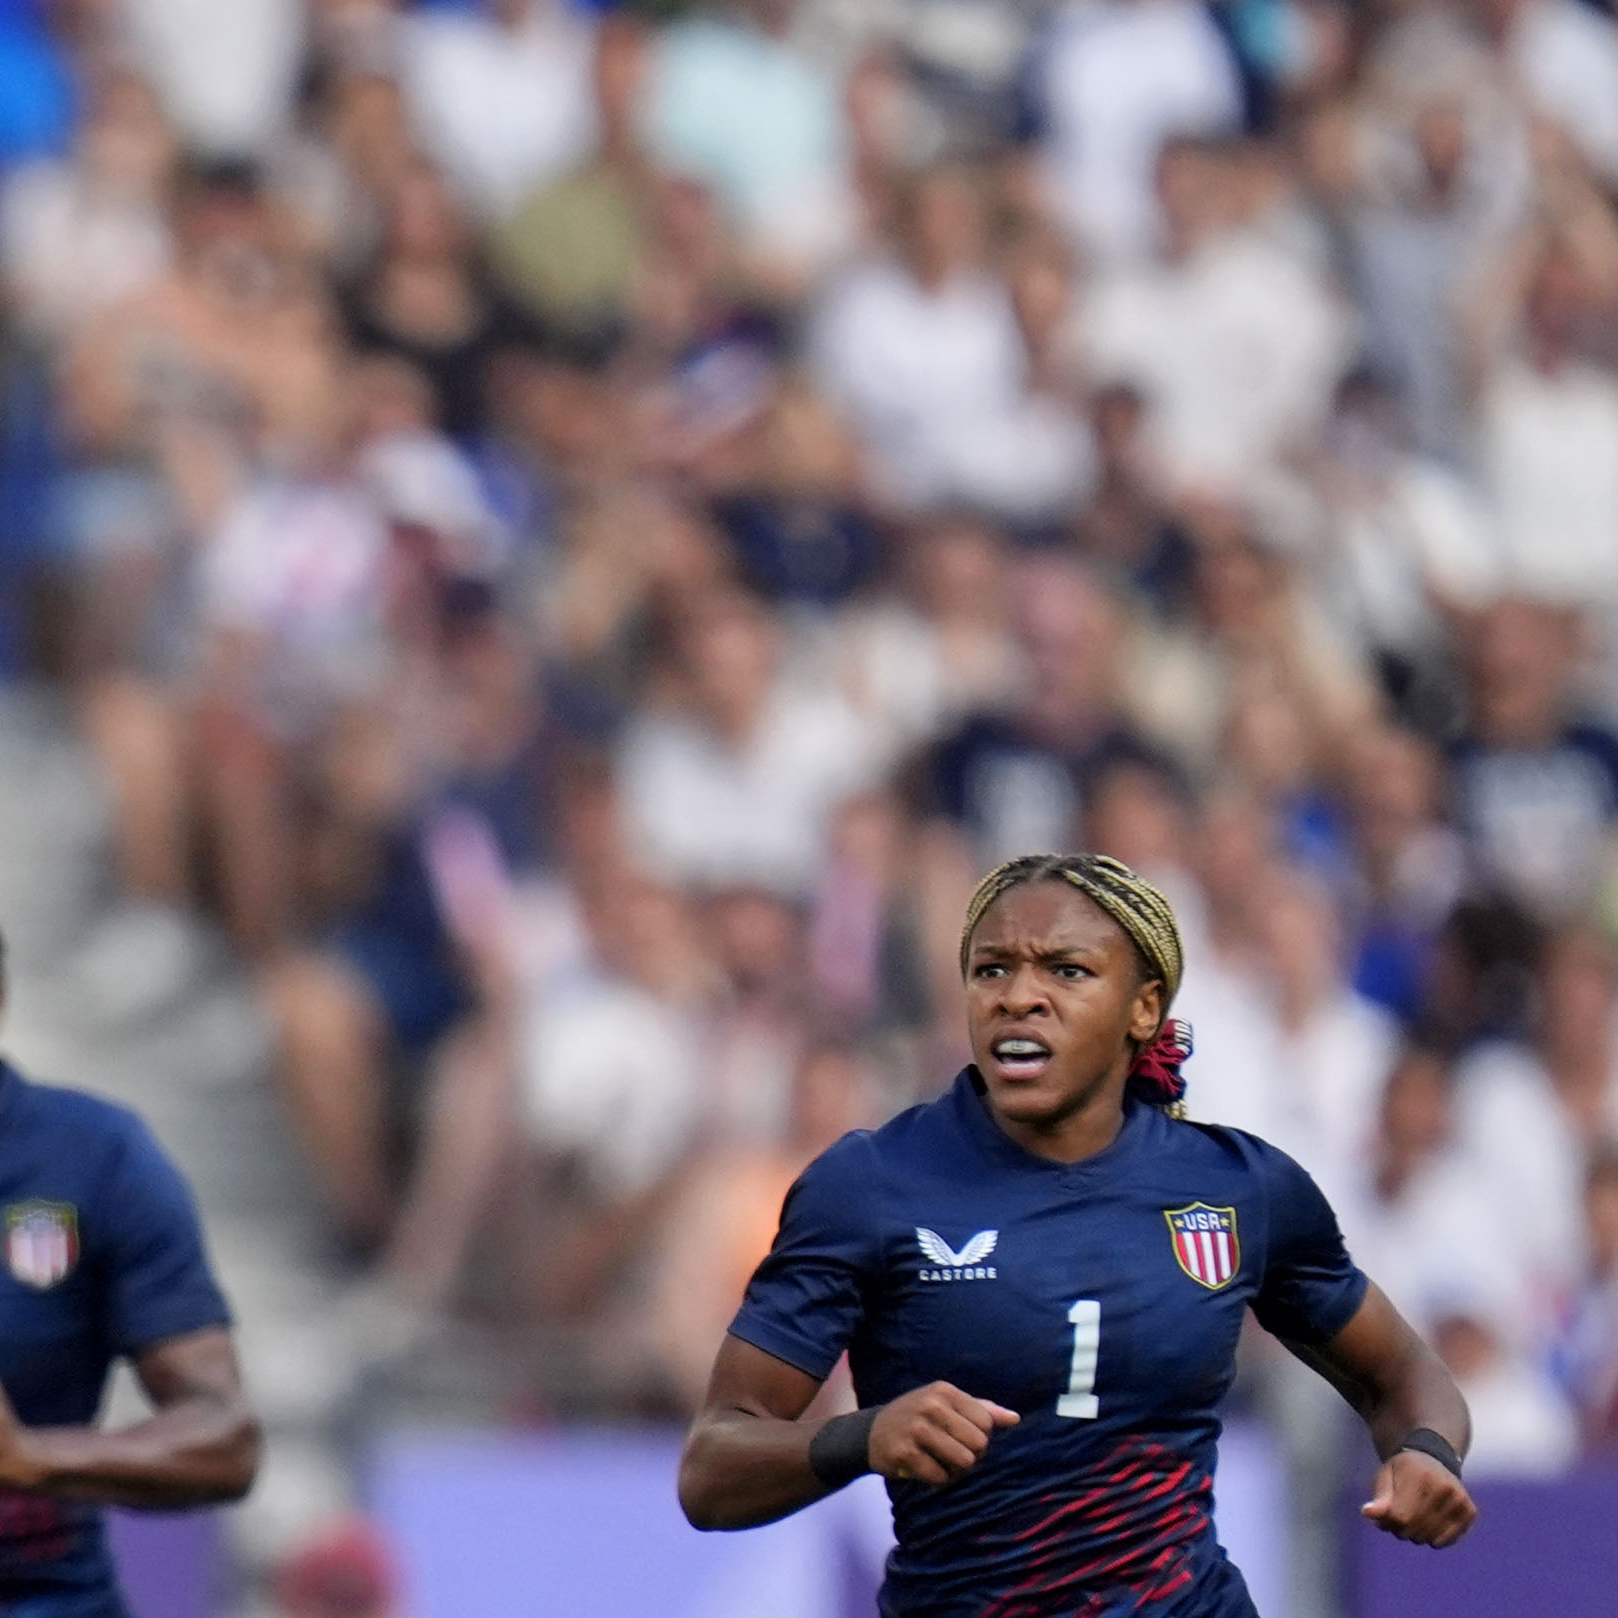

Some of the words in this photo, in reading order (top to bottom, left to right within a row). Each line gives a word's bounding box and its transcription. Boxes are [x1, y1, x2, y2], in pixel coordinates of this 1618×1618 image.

[1184, 1212, 1221, 1231] USA
[919, 1267, 998, 1282] CASTORE
[1056, 1299, 1102, 1419] 1
